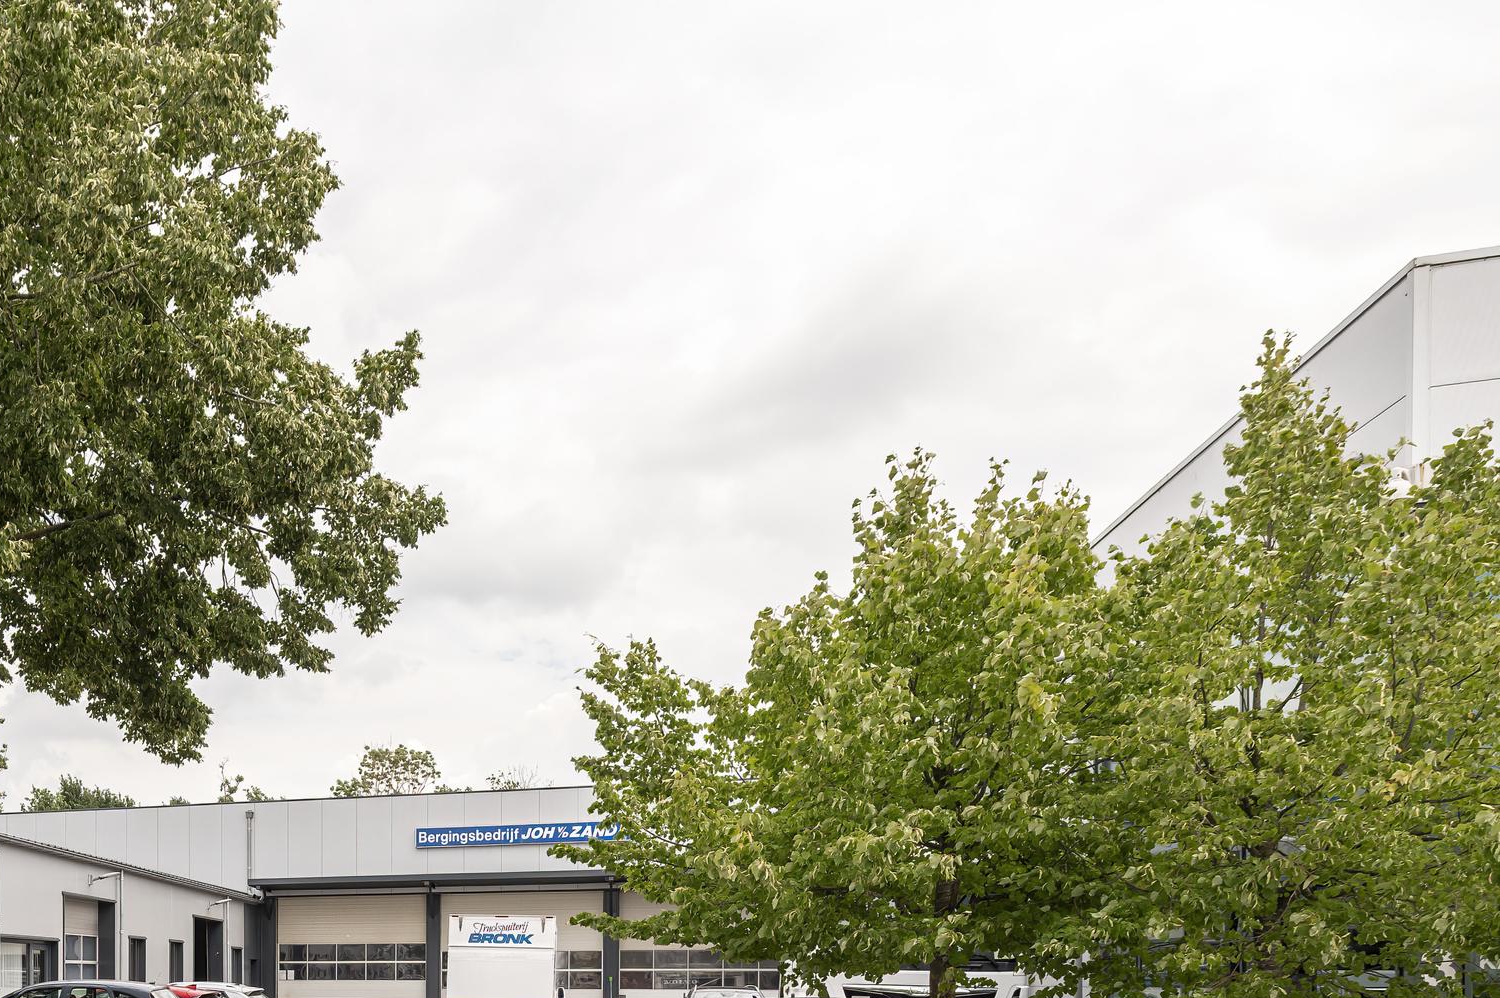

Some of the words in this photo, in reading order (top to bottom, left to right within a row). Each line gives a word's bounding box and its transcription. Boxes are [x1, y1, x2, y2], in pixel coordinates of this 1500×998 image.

[418, 828, 519, 845] Bergingsbedrijf
[521, 826, 555, 840] JOH
[468, 933, 534, 945] BRONK
